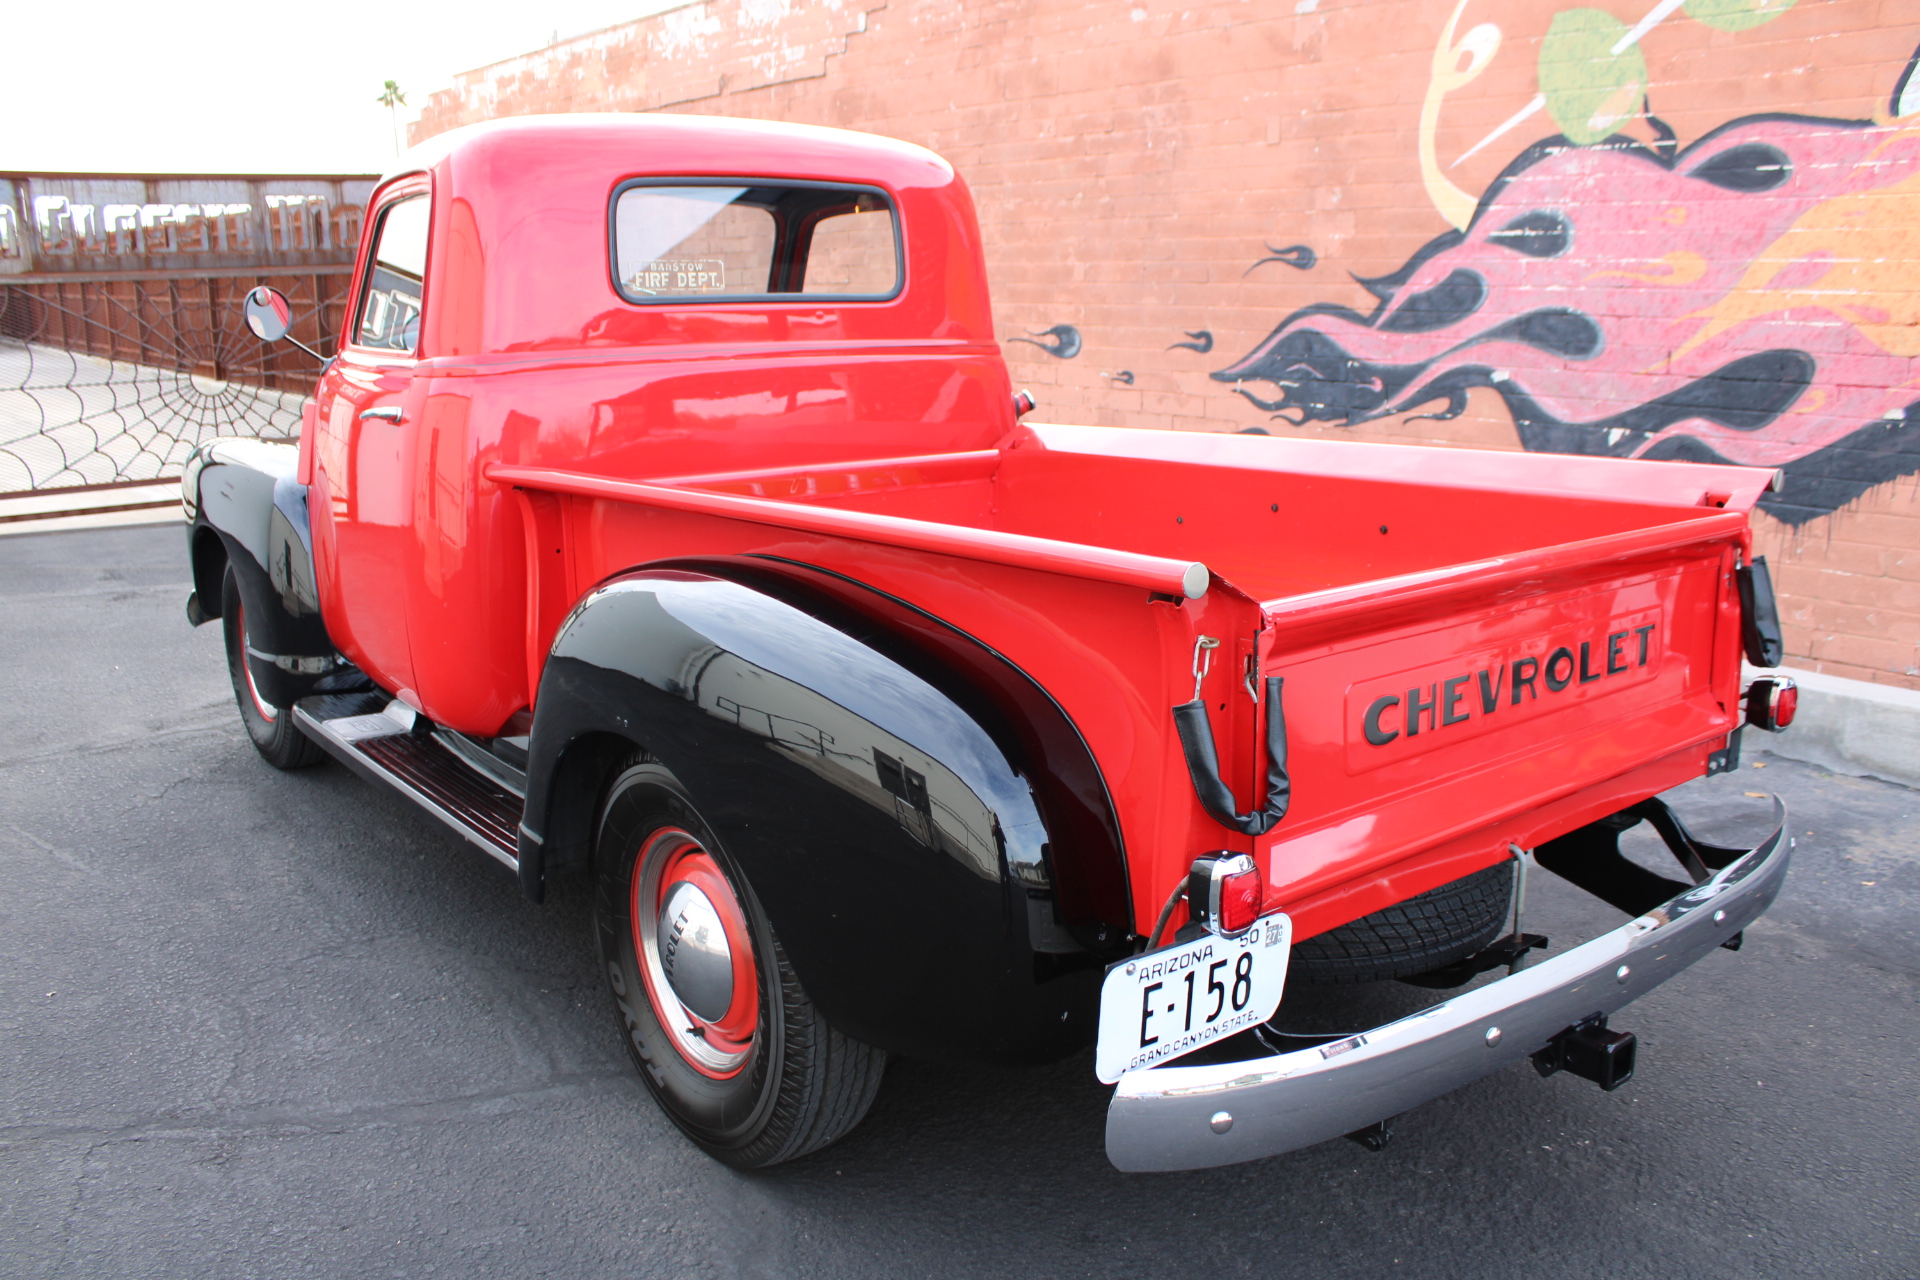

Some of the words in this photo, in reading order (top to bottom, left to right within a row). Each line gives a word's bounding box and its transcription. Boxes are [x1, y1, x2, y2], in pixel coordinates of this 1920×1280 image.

[635, 271, 670, 288] FIRE
[677, 271, 720, 288] DEPT.
[650, 262, 703, 272] BARSTOW
[1363, 624, 1655, 747] CHEVROLET
[1138, 944, 1214, 984] ARIZONA
[1239, 928, 1260, 948] 50
[607, 960, 668, 1089] TOYO
[1139, 951, 1254, 1049] E-158
[1130, 1043, 1171, 1069] GRAND
[1173, 1024, 1219, 1051] CANYON
[1222, 1010, 1255, 1032] STATE
